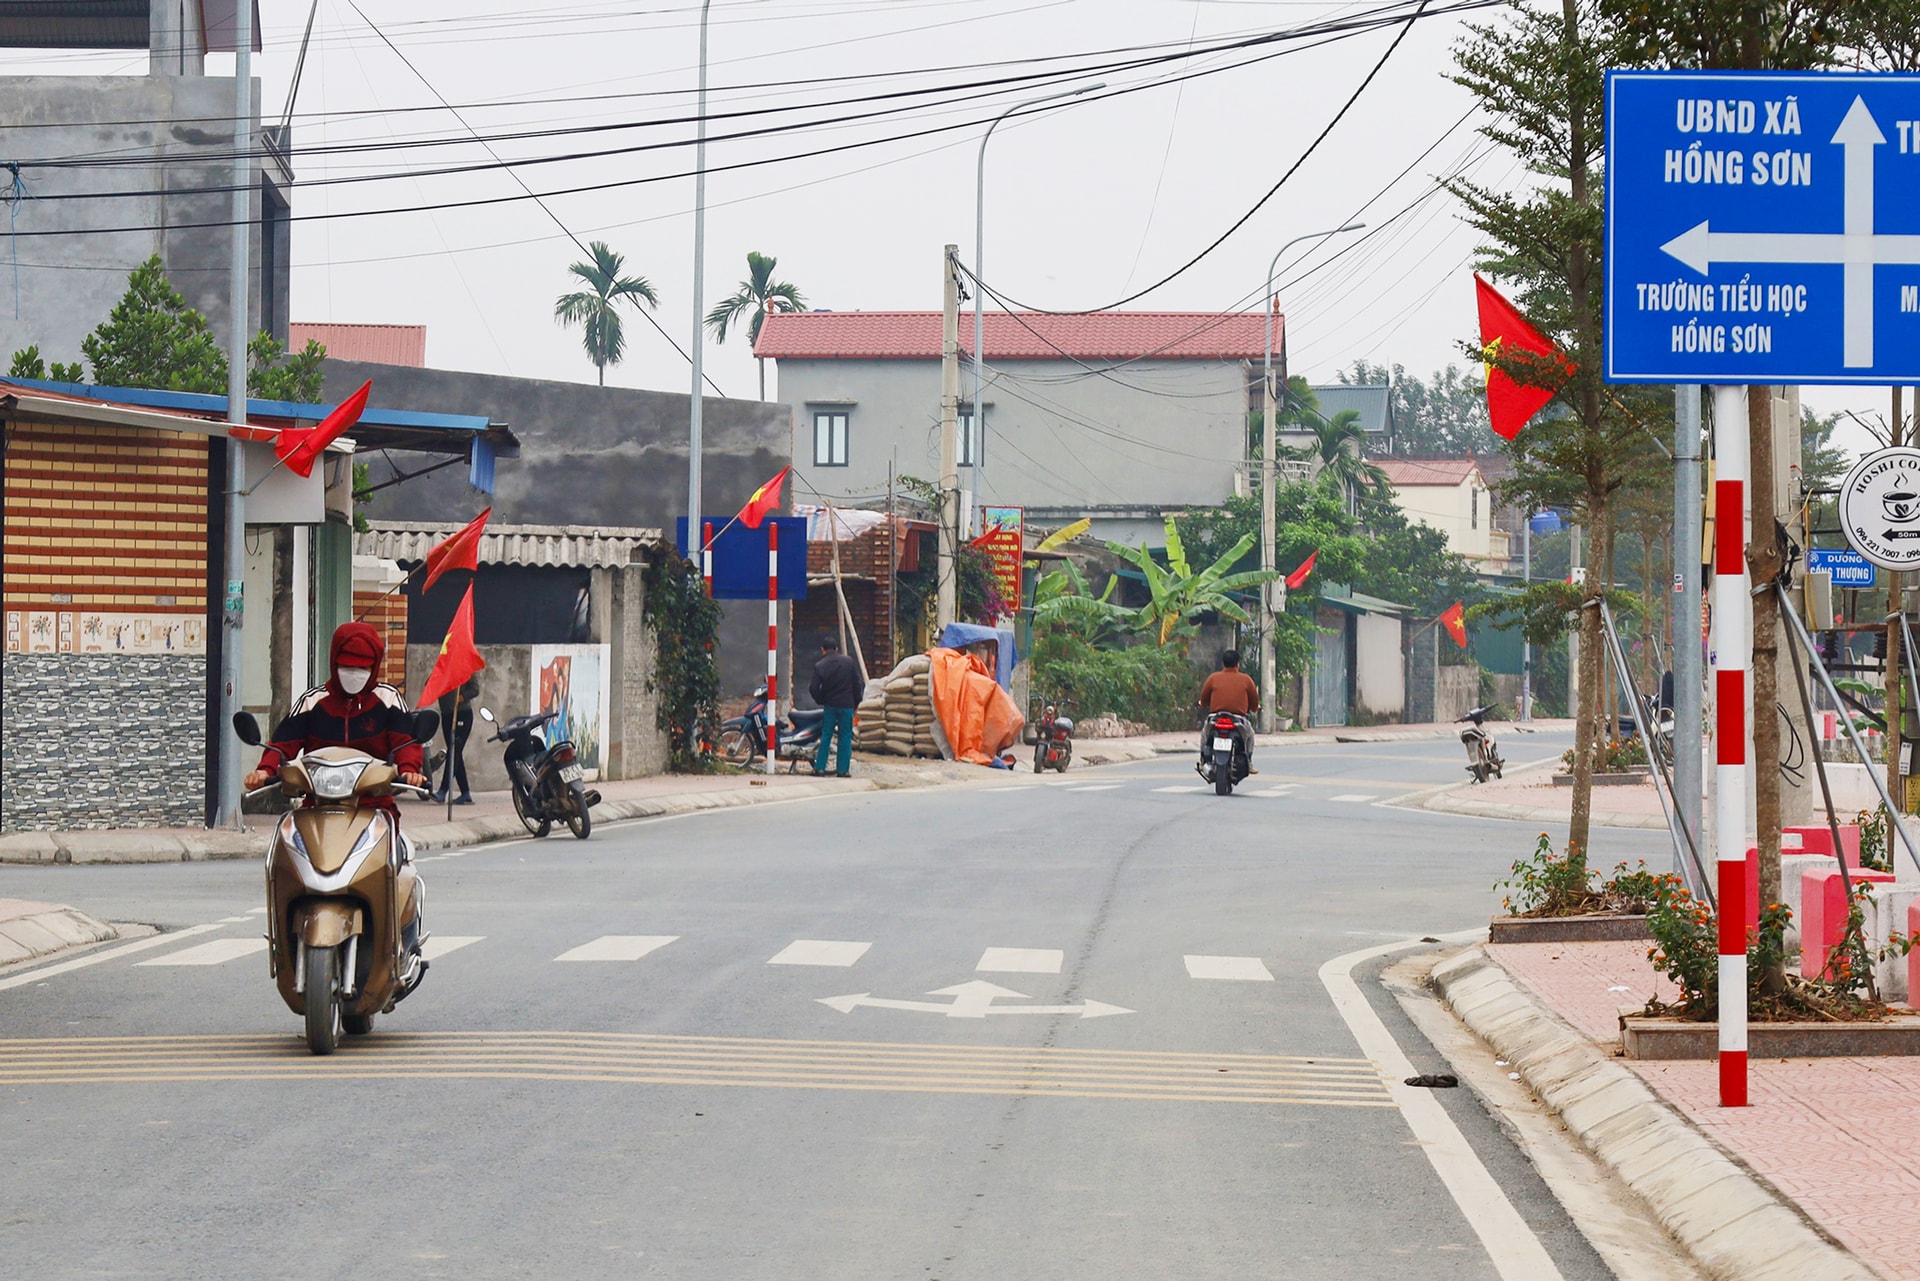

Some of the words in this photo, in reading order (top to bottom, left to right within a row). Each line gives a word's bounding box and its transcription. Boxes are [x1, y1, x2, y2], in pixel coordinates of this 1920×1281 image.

[1676, 98, 1756, 134] UBND
[1763, 95, 1802, 135] XÃ
[1664, 140, 1744, 185] HỒNG
[1751, 149, 1812, 186] SƠN
[1636, 278, 1715, 312] TRƯỜNG
[1719, 273, 1762, 312] TIỂU
[1767, 284, 1807, 317] HỌC
[1671, 316, 1726, 353] HỒNG
[1731, 323, 1772, 353] SƠN
[1856, 460, 1894, 494] HOSHI
[1898, 459, 1920, 472] CO
[1856, 527, 1868, 541] 096
[1866, 539, 1880, 552] 221
[1880, 547, 1900, 559] 7007
[1835, 566, 1869, 582] THƯỢNG
